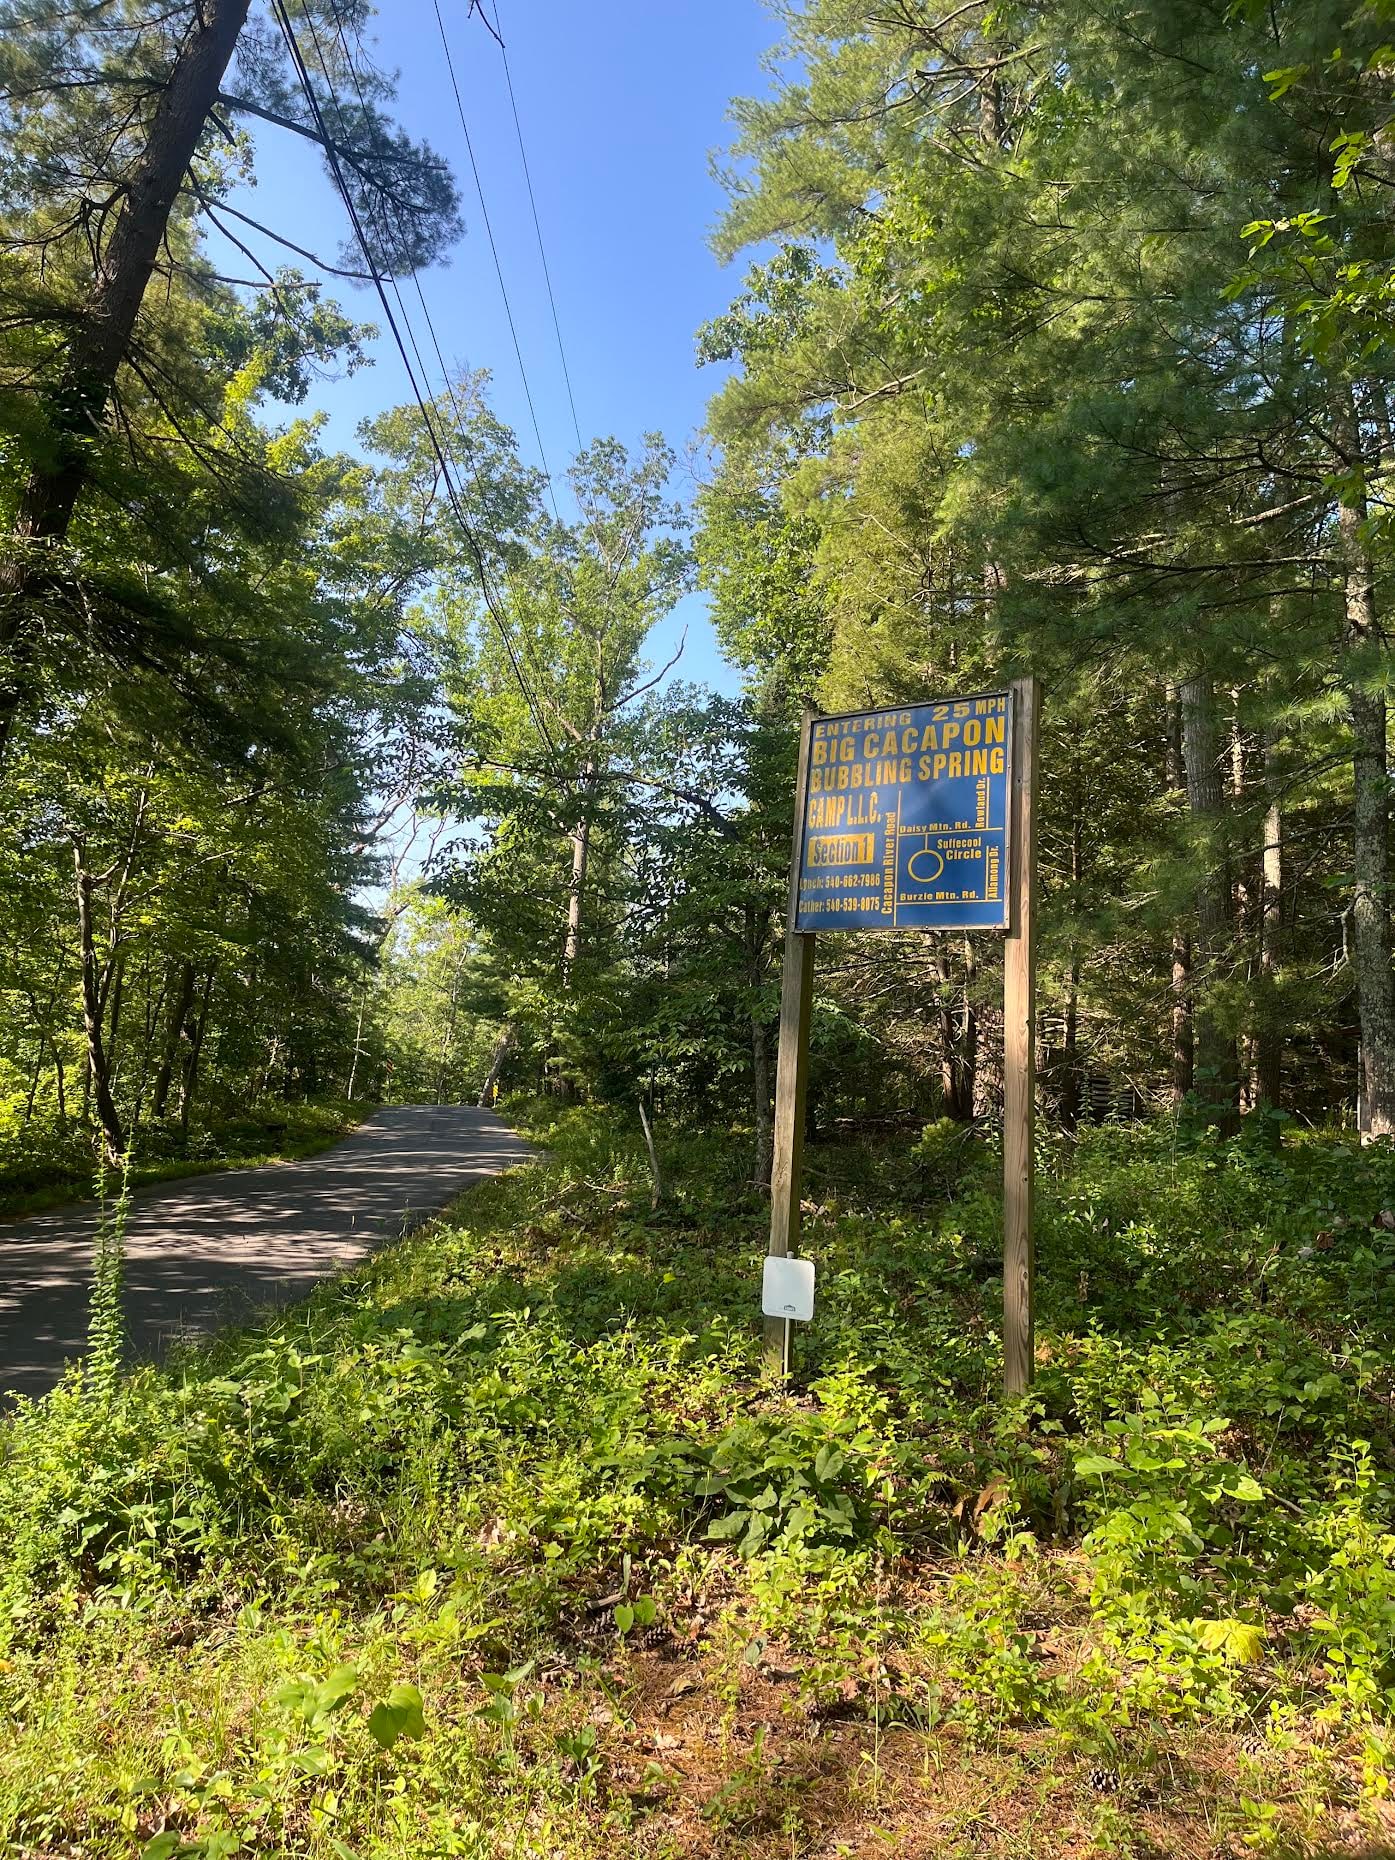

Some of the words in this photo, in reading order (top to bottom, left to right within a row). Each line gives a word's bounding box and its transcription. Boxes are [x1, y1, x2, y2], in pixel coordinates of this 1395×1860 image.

[932, 702, 970, 721] 25
[975, 698, 1006, 715] MPH
[815, 712, 912, 738] ENTERING
[813, 736, 856, 765] BIG
[863, 715, 1005, 758] CACAPON
[810, 757, 912, 794] BUBBLING
[918, 747, 1004, 781] SPRING
[976, 777, 986, 789] Dr.
[809, 795, 845, 829] CAMP
[975, 791, 986, 828] Rowland
[884, 811, 896, 836] Road
[900, 825, 927, 833] Daisy
[929, 822, 952, 831] Mtn.
[955, 821, 971, 830] Rd.
[814, 839, 858, 864] Section
[863, 836, 868, 860] 1
[883, 838, 894, 866] River
[937, 837, 982, 849] Suffecool
[945, 849, 982, 860] Circle
[989, 845, 999, 857] Dr.
[881, 868, 894, 914] Cacapon
[988, 859, 1000, 898] Allamong
[799, 900, 824, 913] Cather:
[935, 891, 959, 900] Mtn.
[962, 890, 979, 899] Rd.
